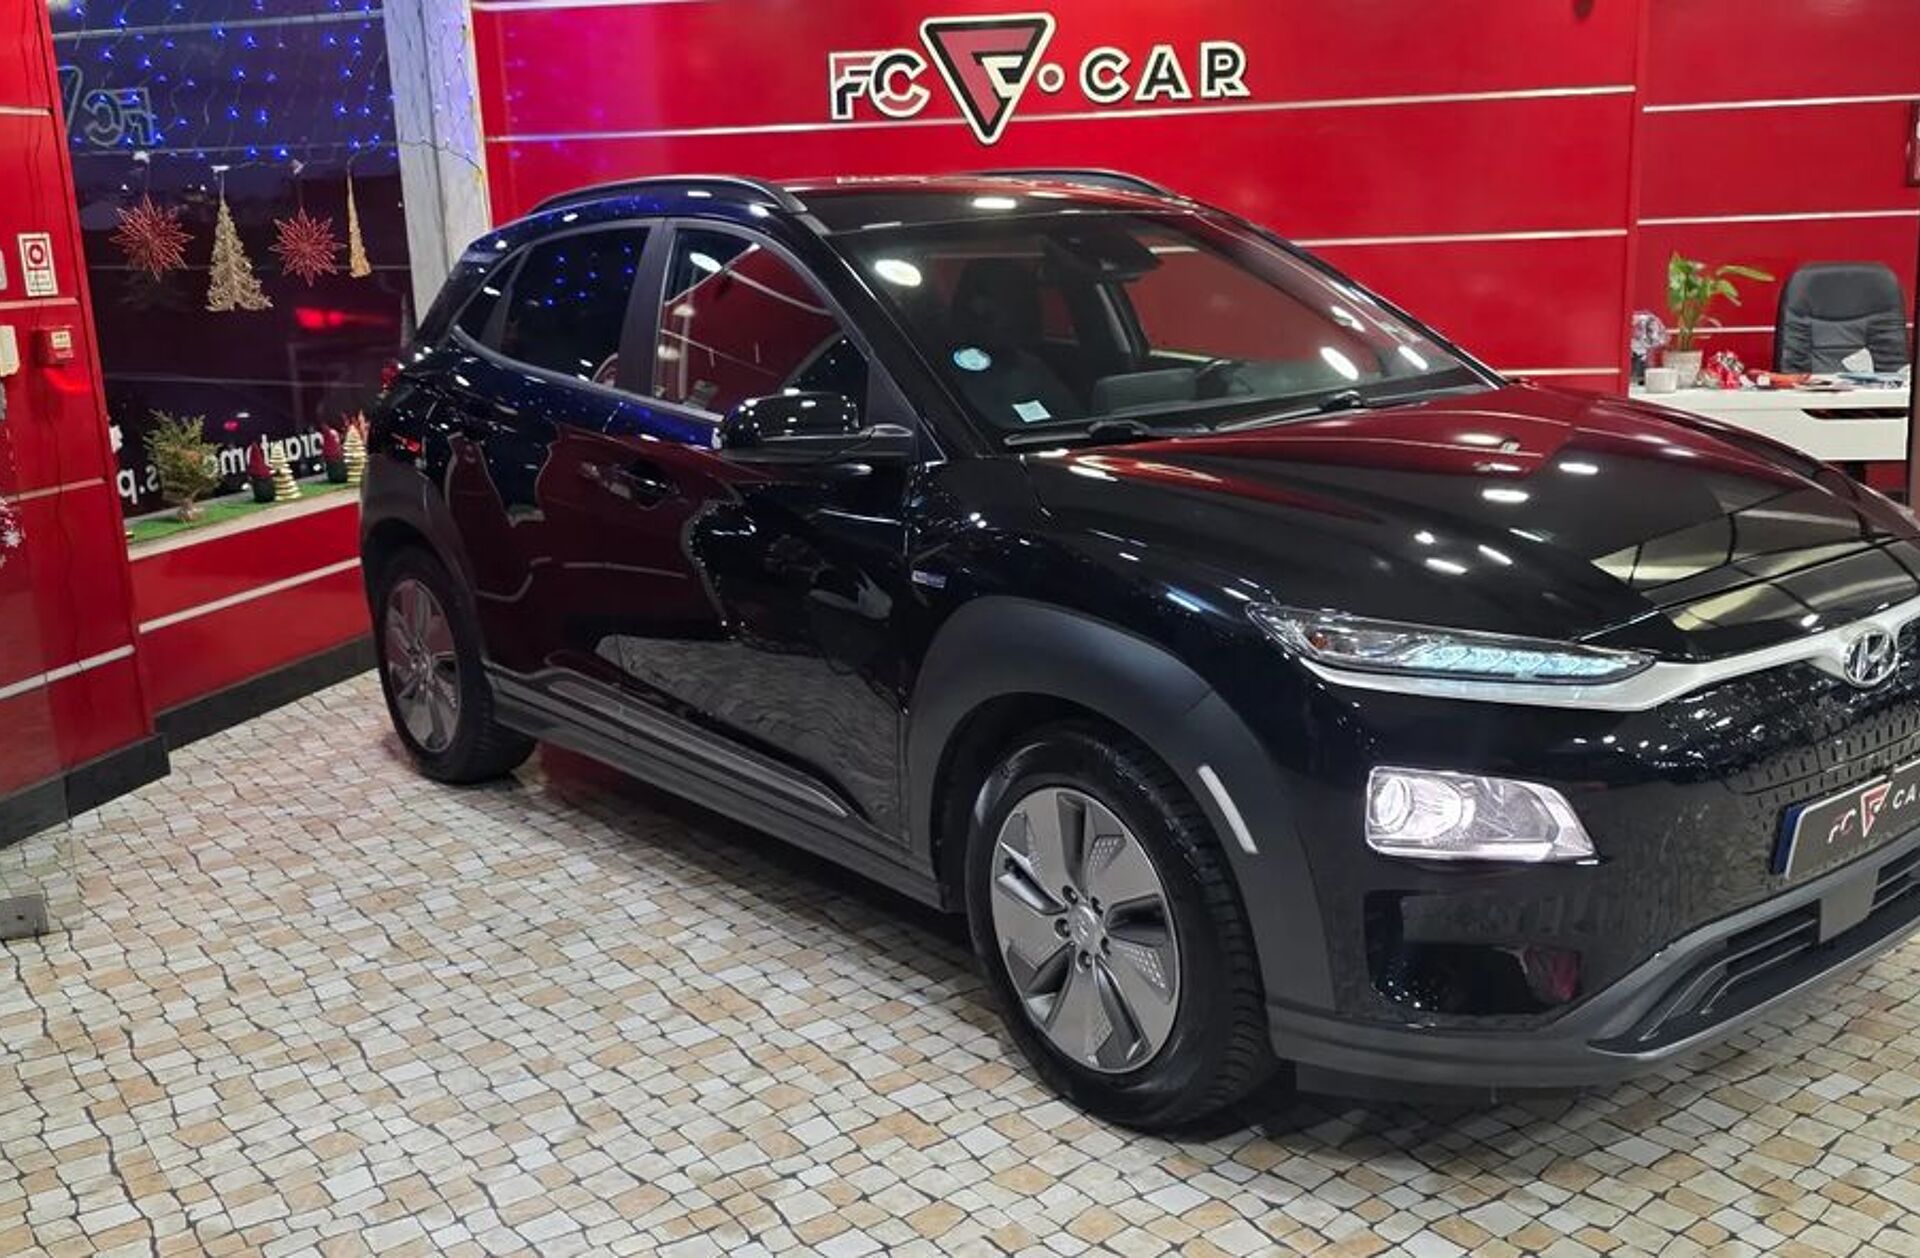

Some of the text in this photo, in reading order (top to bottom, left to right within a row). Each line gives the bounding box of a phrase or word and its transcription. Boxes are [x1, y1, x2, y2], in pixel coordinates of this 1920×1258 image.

[828, 49, 930, 120] FC
[1079, 41, 1250, 103] CAR
[1893, 783, 1920, 810] CA
